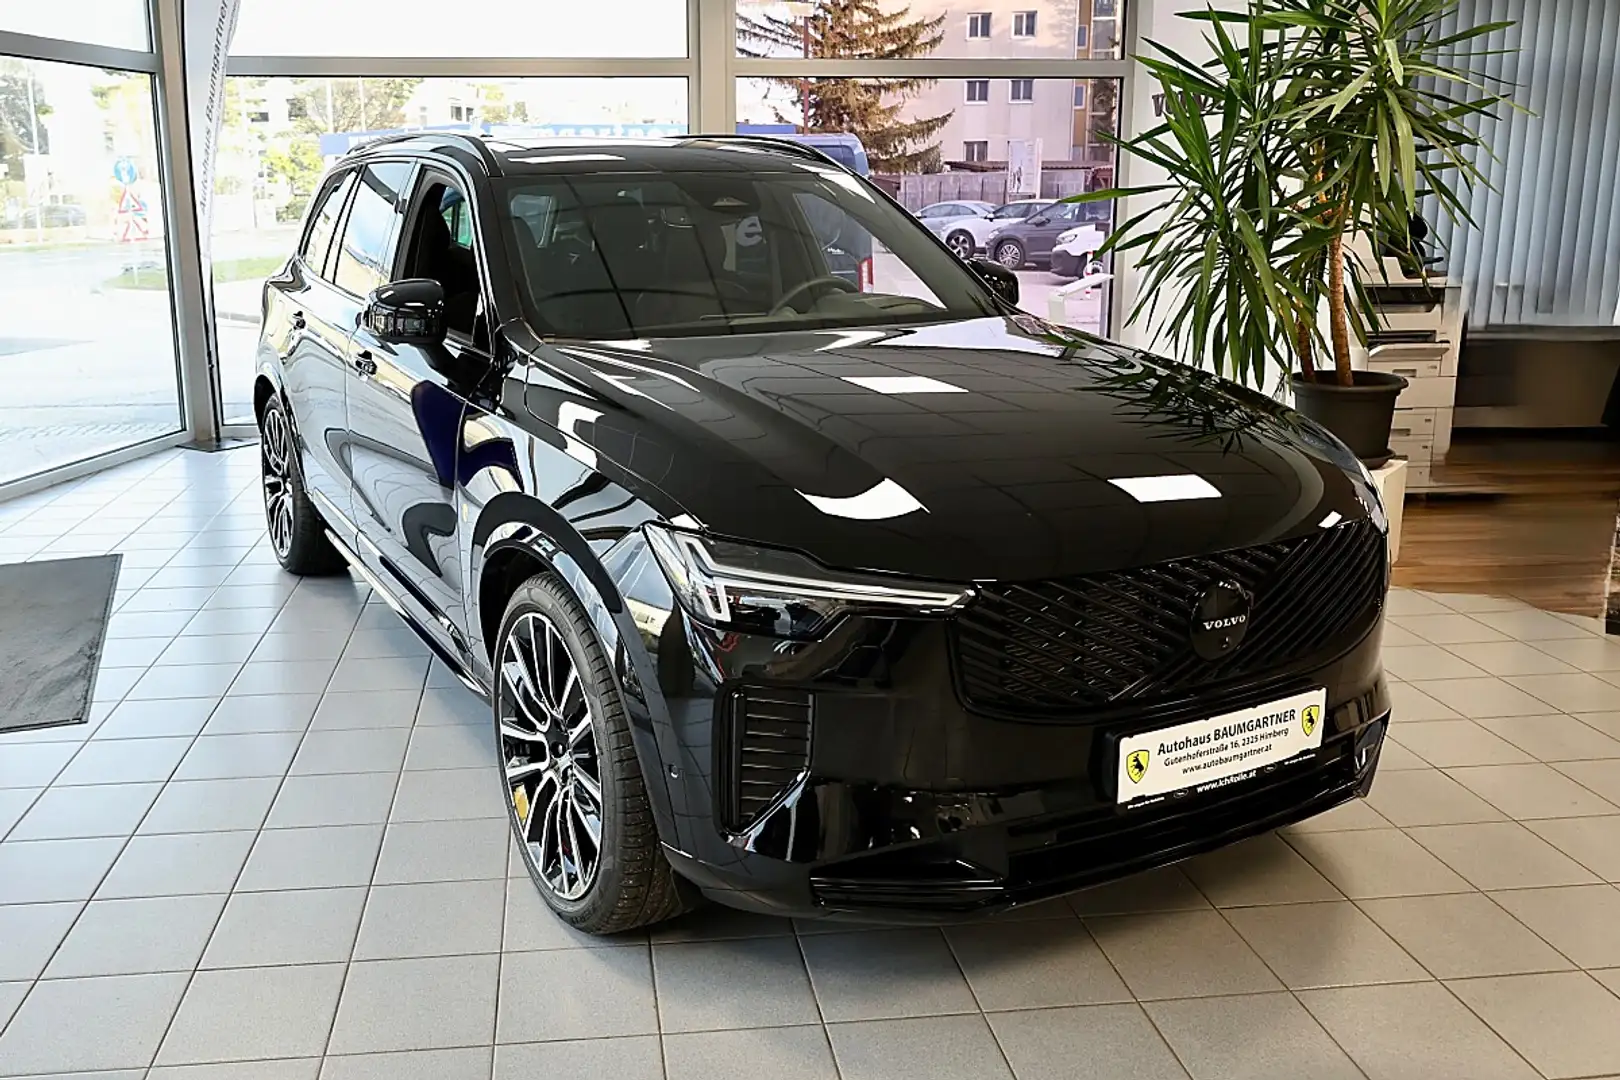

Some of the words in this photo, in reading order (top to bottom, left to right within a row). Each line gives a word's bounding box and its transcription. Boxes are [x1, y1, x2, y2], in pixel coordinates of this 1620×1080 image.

[199, 126, 212, 216] Autohaus
[206, 0, 228, 124] Baumgartner
[1203, 614, 1246, 630] VOLVO
[1157, 735, 1211, 756] Autohaus
[1213, 709, 1296, 740] BAUMGARTNER
[1164, 744, 1229, 767] Gutenhoferstraße
[1230, 739, 1240, 751] 16,
[1242, 735, 1259, 750] 2325
[1260, 728, 1289, 742] Himberg
[1182, 743, 1272, 774] www.autobaumgartner.at
